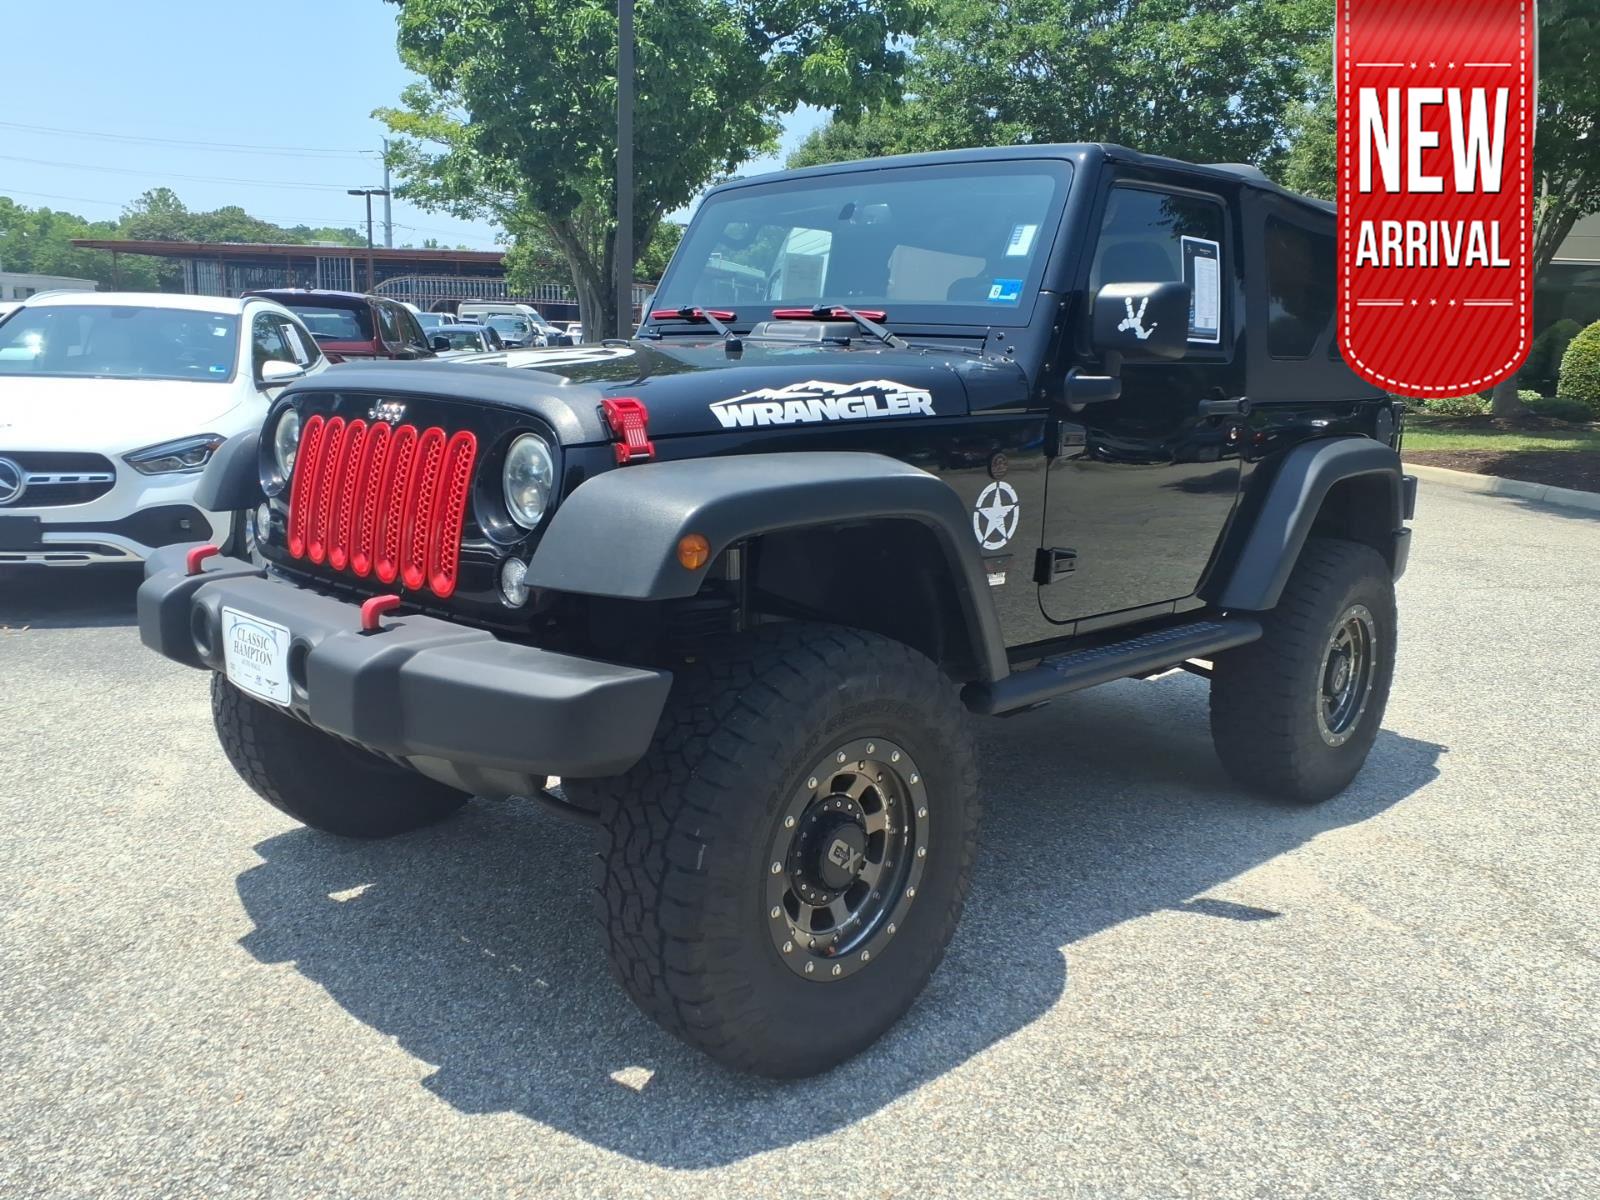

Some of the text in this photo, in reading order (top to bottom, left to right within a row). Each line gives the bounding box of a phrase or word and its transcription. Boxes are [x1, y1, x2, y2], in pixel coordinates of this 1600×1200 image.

[368, 398, 406, 426] Jeep
[709, 391, 936, 428] WRANGLER
[237, 627, 270, 651] CLASSIC
[233, 640, 273, 667] HAMPTON
